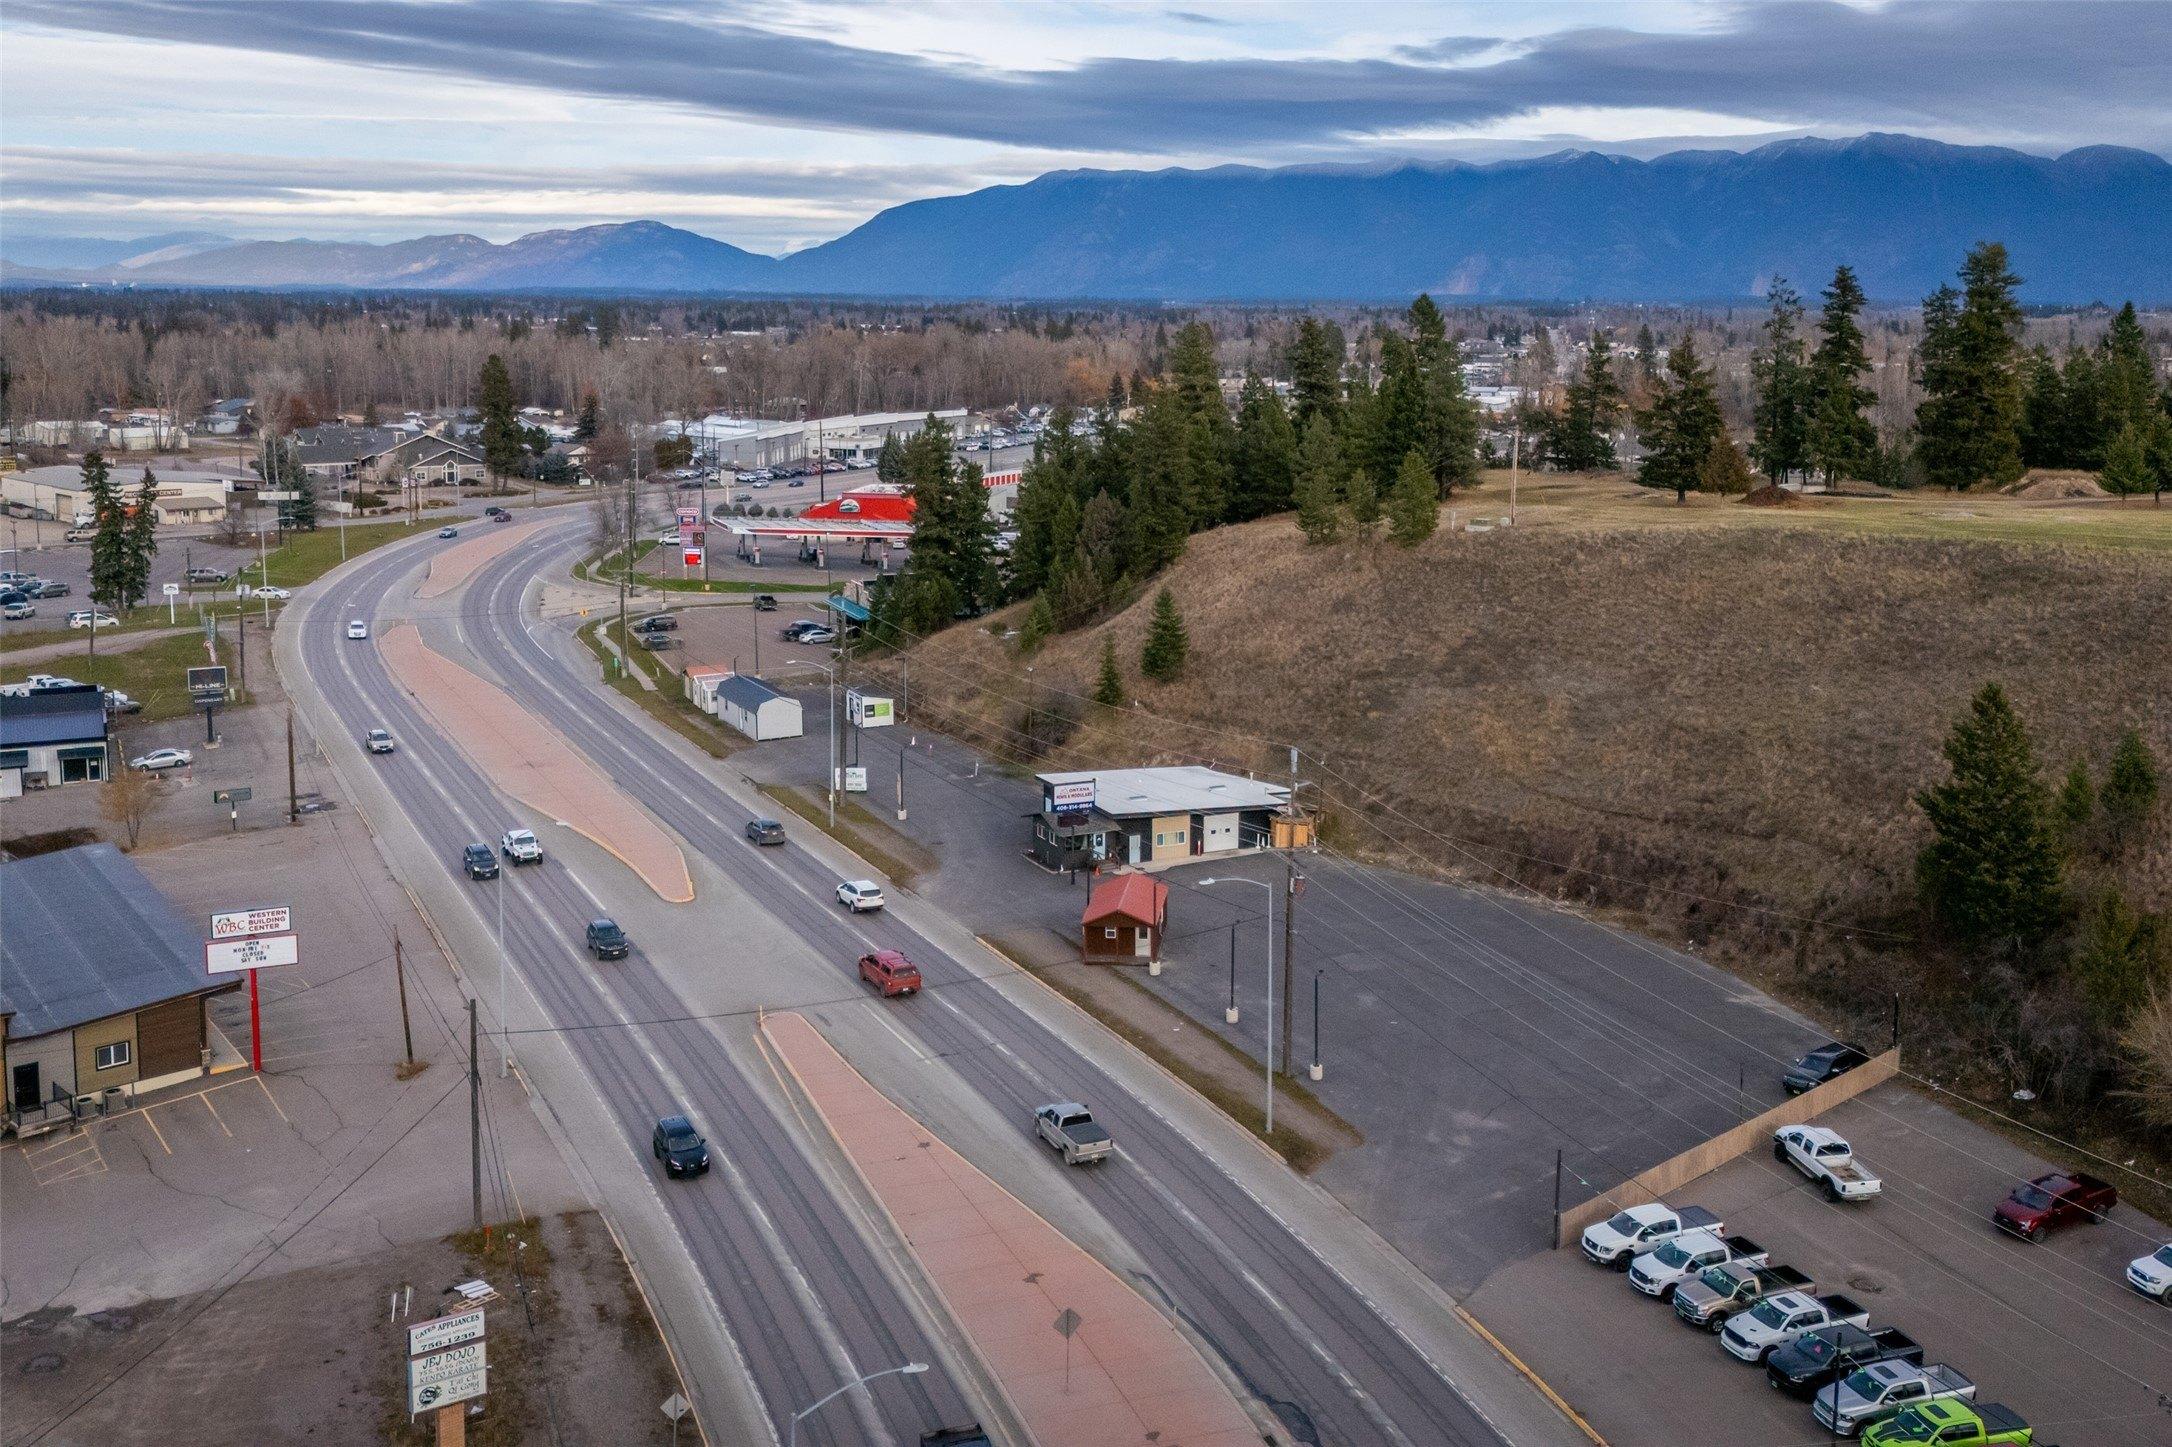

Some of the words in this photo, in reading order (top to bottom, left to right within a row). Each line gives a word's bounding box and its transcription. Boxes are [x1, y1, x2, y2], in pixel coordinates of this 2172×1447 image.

[249, 910, 287, 918] WESTERN
[249, 916, 286, 925] BUILDING
[216, 920, 246, 934] WBC
[249, 923, 280, 931] CENTER
[437, 1313, 480, 1332] APPLIANCES
[420, 1331, 475, 1351] 756-1239
[445, 1346, 476, 1363] DOJO
[448, 1363, 478, 1377] KARATE
